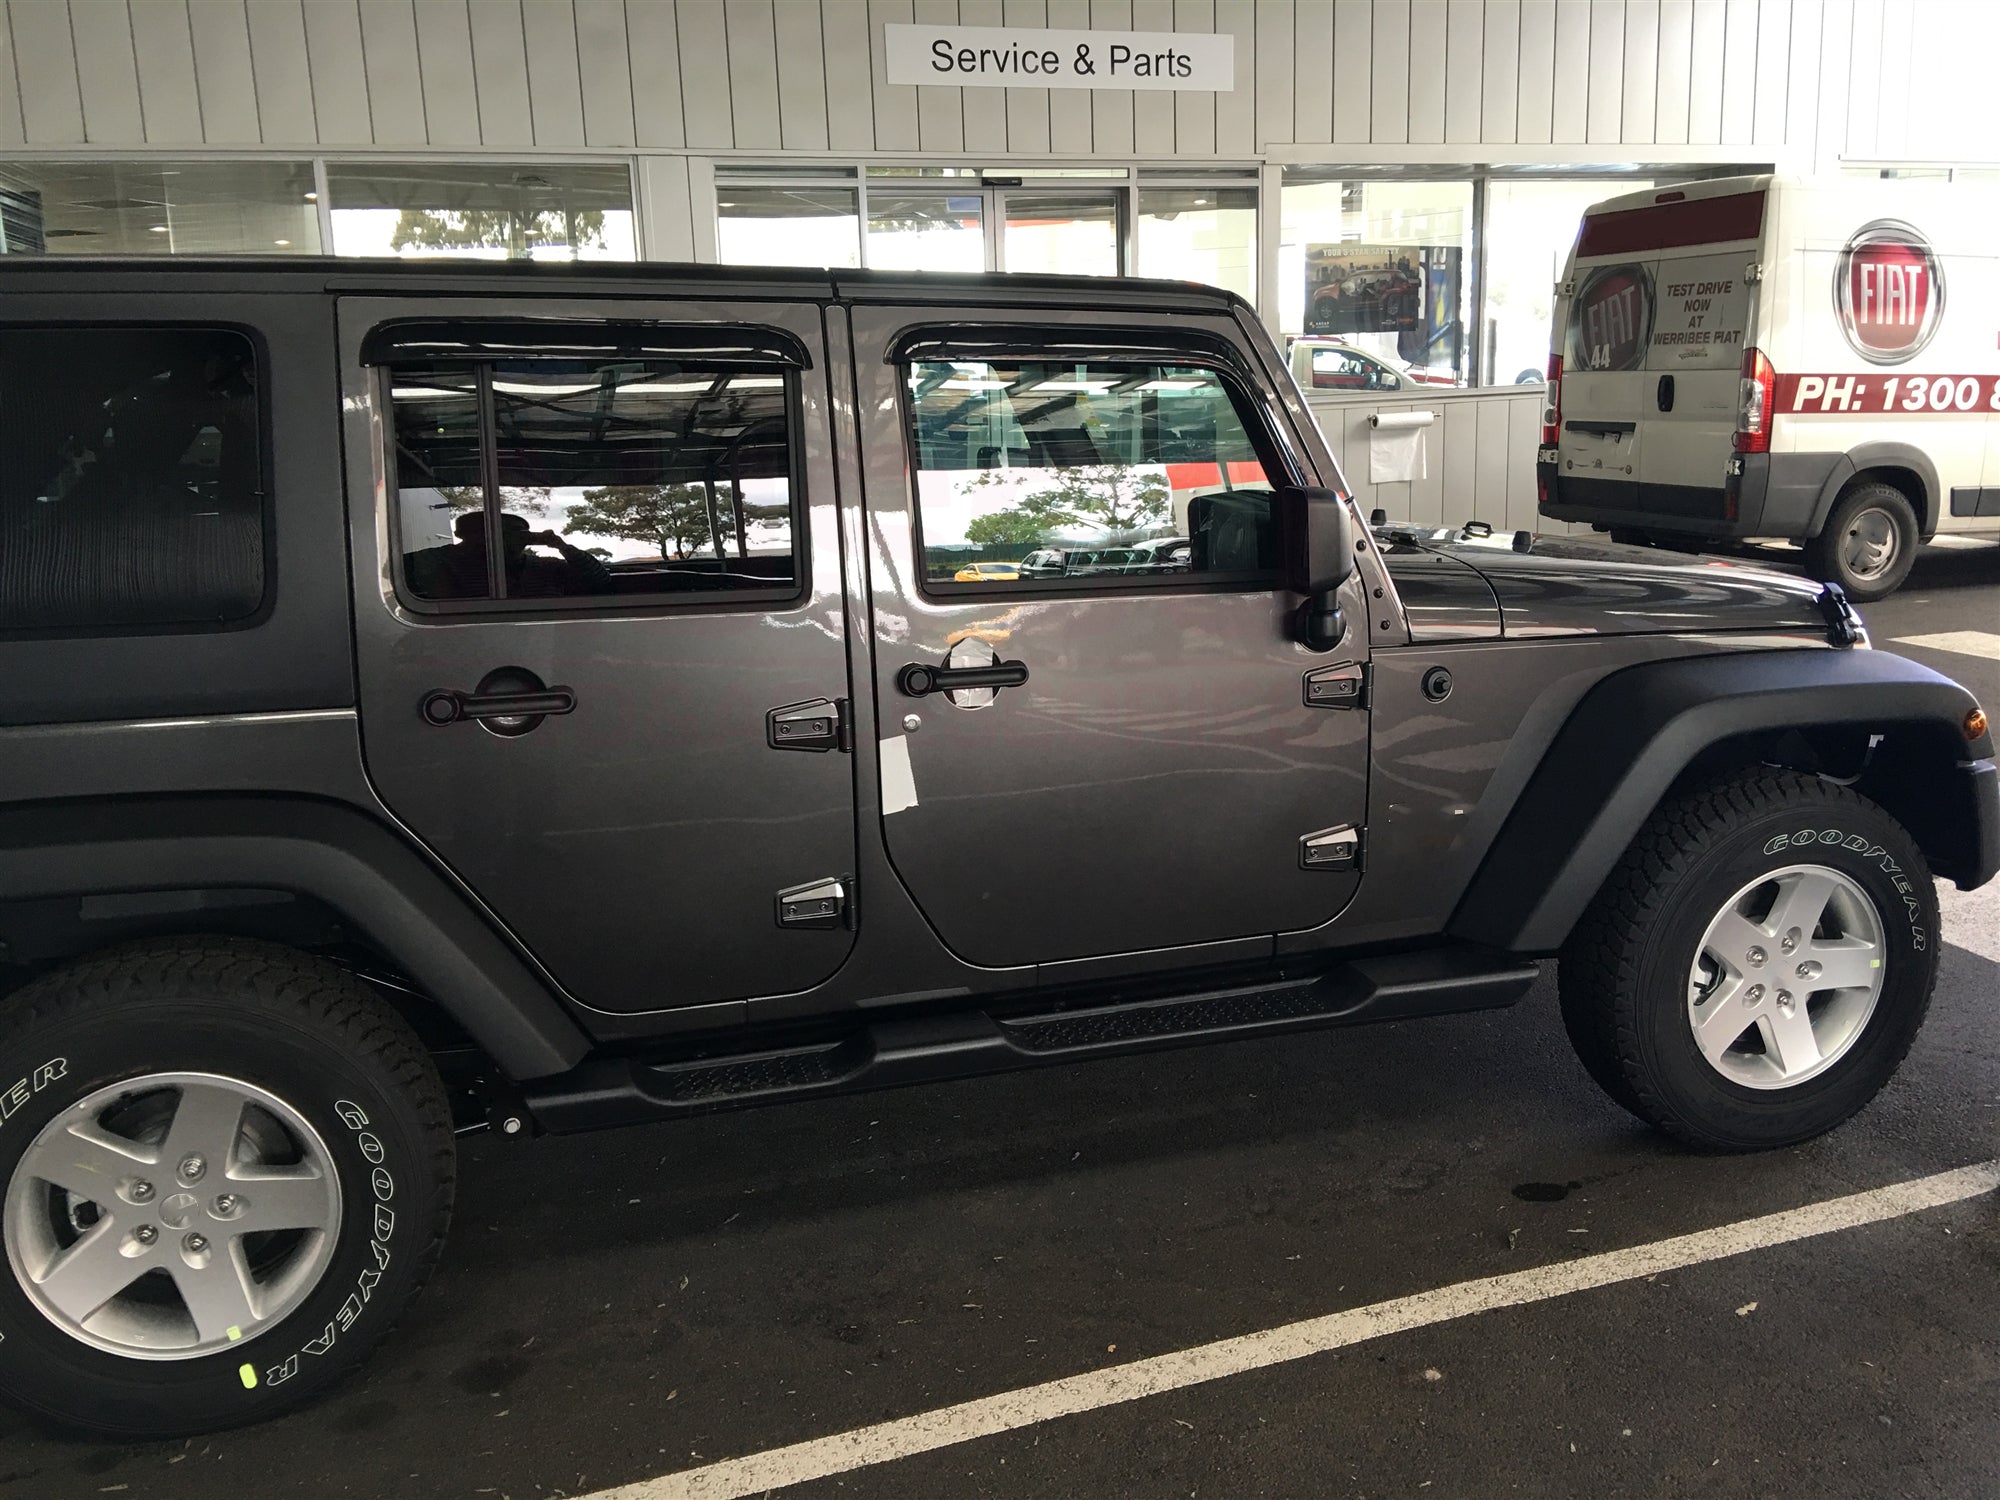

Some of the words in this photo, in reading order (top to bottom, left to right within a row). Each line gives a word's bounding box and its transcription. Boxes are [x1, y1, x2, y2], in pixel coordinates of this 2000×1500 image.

[930, 39, 1060, 75] Service
[1073, 43, 1096, 76] &
[1109, 44, 1193, 78] Parts
[1667, 283, 1695, 297] TEST
[1696, 280, 1733, 295] DRIVE
[1683, 298, 1712, 313] NOW
[1859, 263, 1923, 326] FIAT
[1588, 285, 1635, 350] FIAT
[1688, 315, 1704, 329] AT
[1591, 343, 1611, 368] 44
[1653, 331, 1711, 345] WERRIBEE
[1713, 330, 1741, 344] FIAT
[1793, 376, 1865, 411] PH:
[1882, 377, 1981, 412] 1300
[1763, 829, 1926, 952] GOODYEAR
[0, 1057, 68, 1120] ER
[266, 1099, 395, 1386] GOODYEAR
